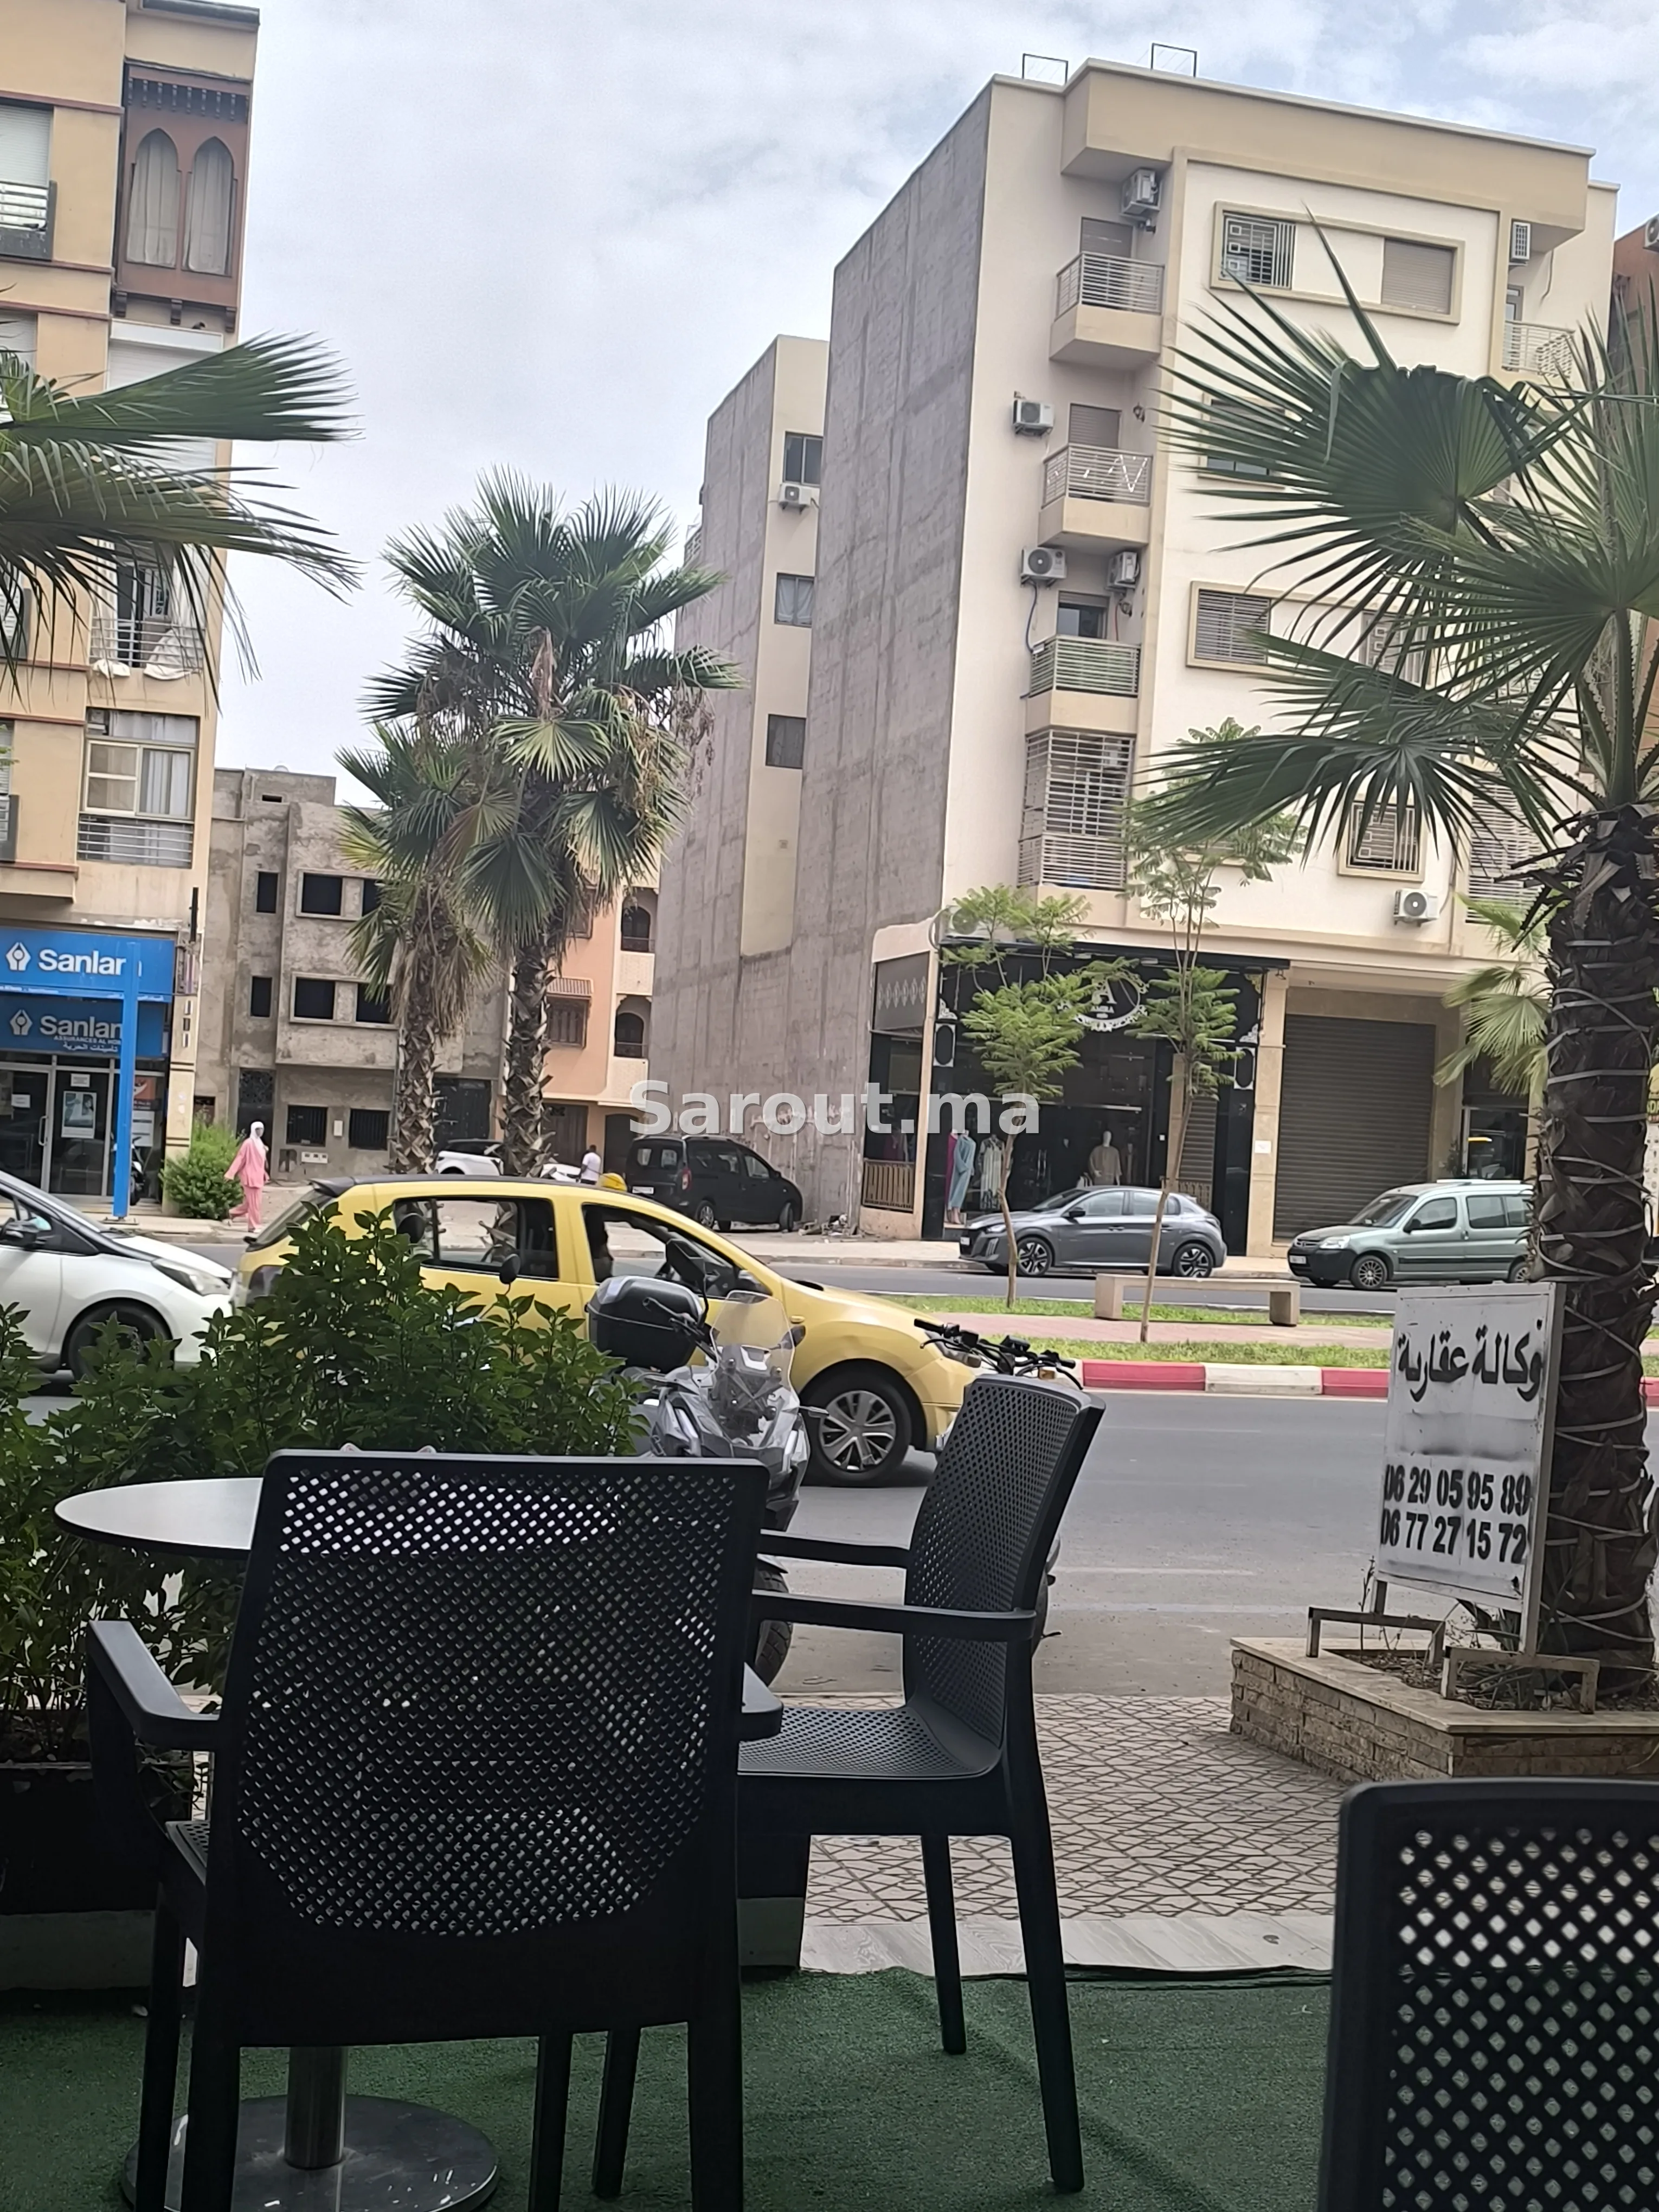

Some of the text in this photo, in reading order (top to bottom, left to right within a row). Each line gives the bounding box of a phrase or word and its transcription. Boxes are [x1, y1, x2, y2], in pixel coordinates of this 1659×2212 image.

[1384, 1464, 1532, 1516] 06 29 05 95 89
[1380, 1508, 1527, 1564] 06 77 27 15 72
